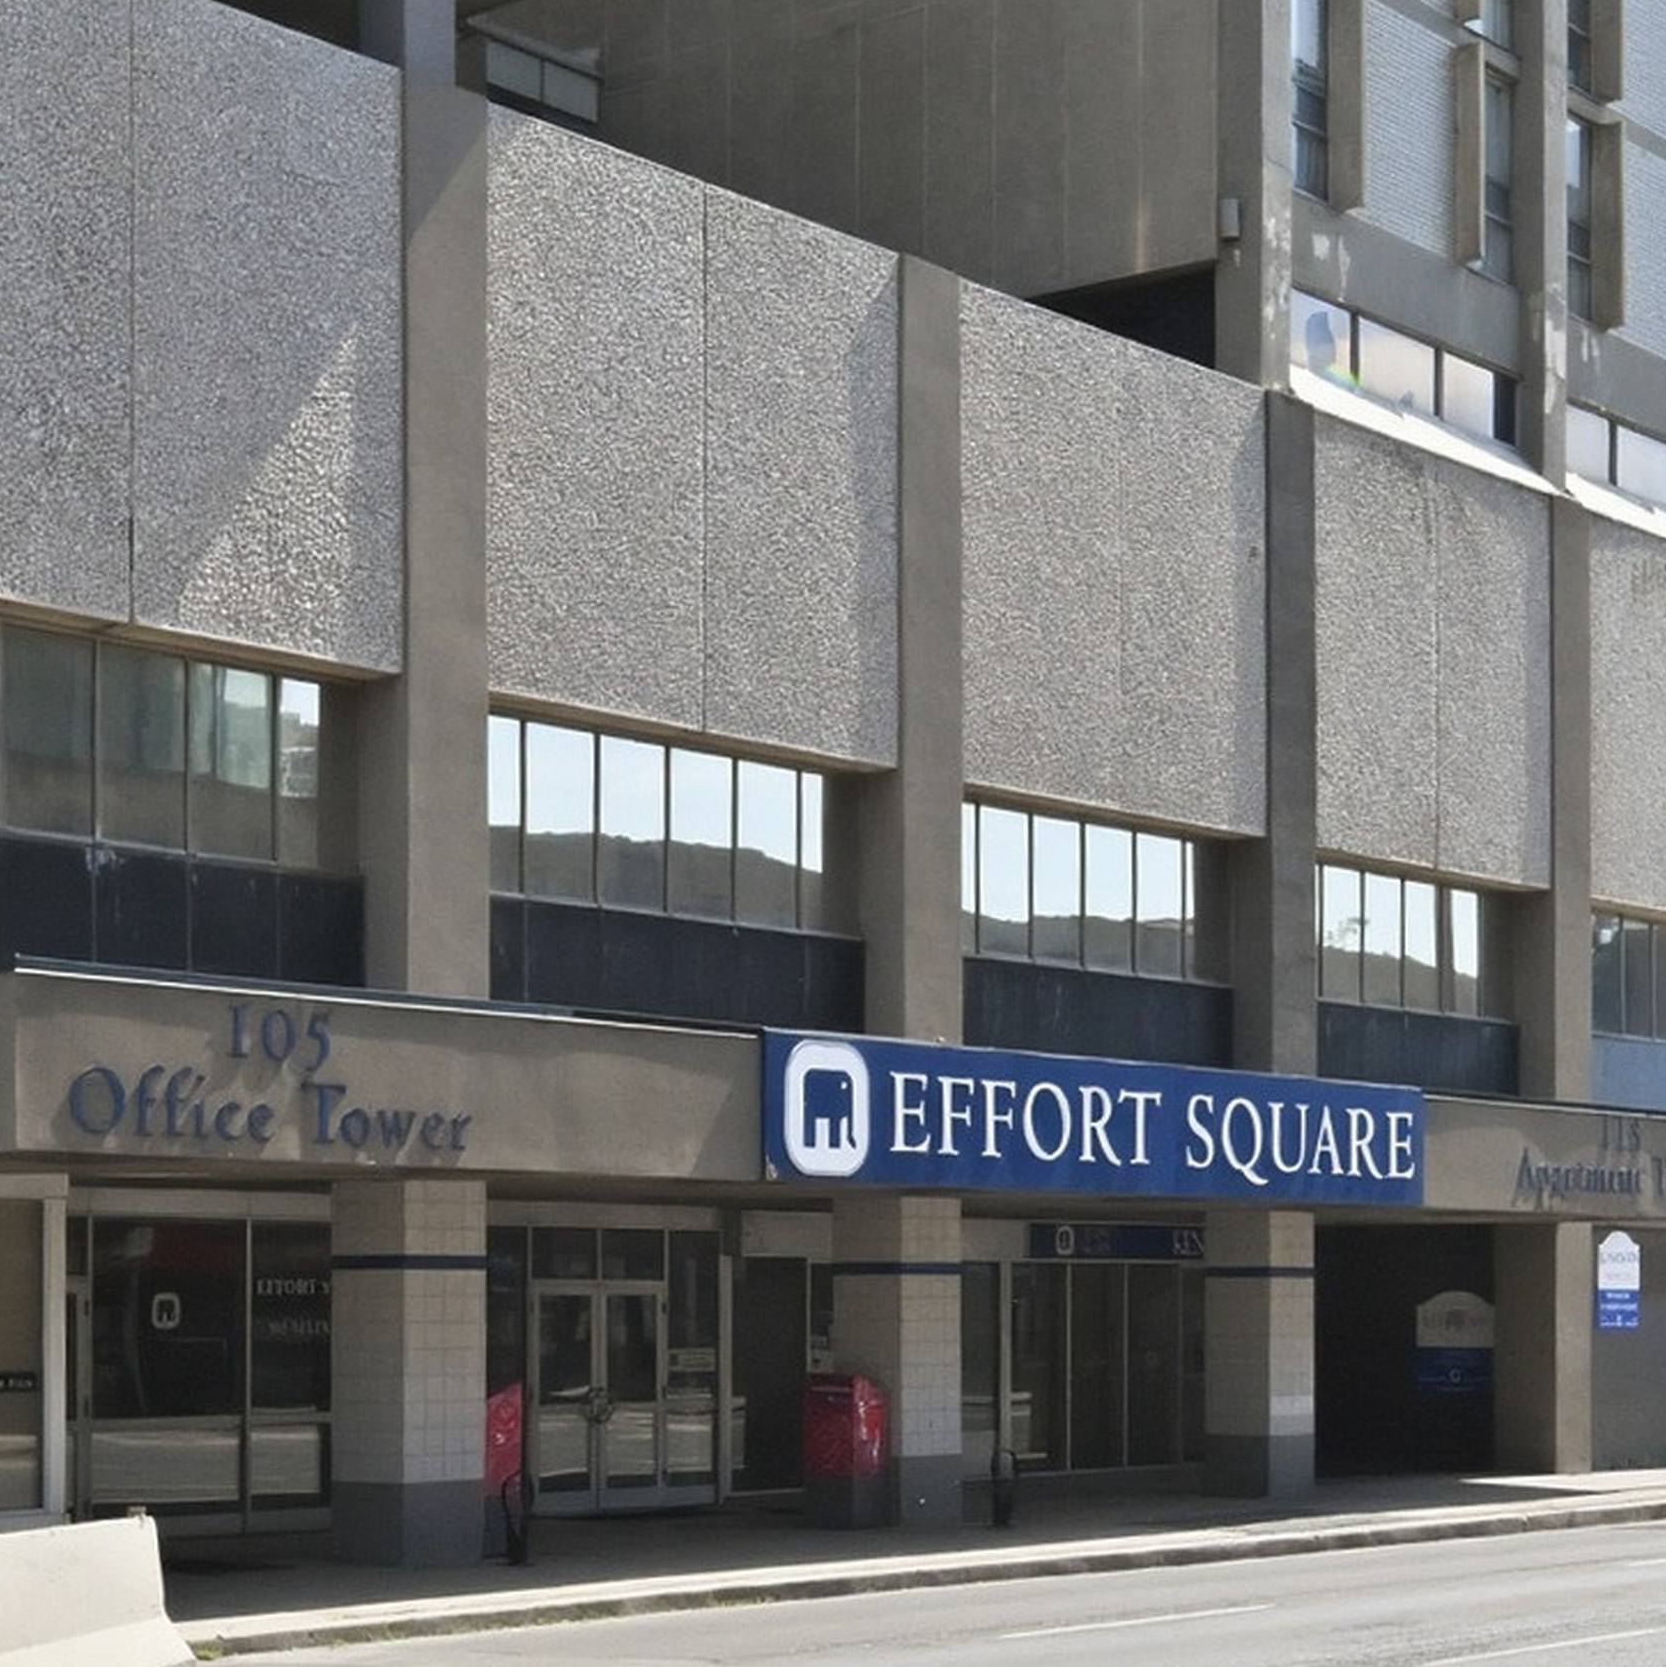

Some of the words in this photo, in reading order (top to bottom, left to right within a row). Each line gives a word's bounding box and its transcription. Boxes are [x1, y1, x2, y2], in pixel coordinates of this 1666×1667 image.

[227, 1003, 331, 1071] 105
[68, 1064, 275, 1144] Office
[300, 1082, 472, 1151] Tower
[890, 1071, 1161, 1167] EFFORT
[1186, 1094, 1416, 1185] SQUARE
[1514, 1146, 1642, 1198] Apartment
